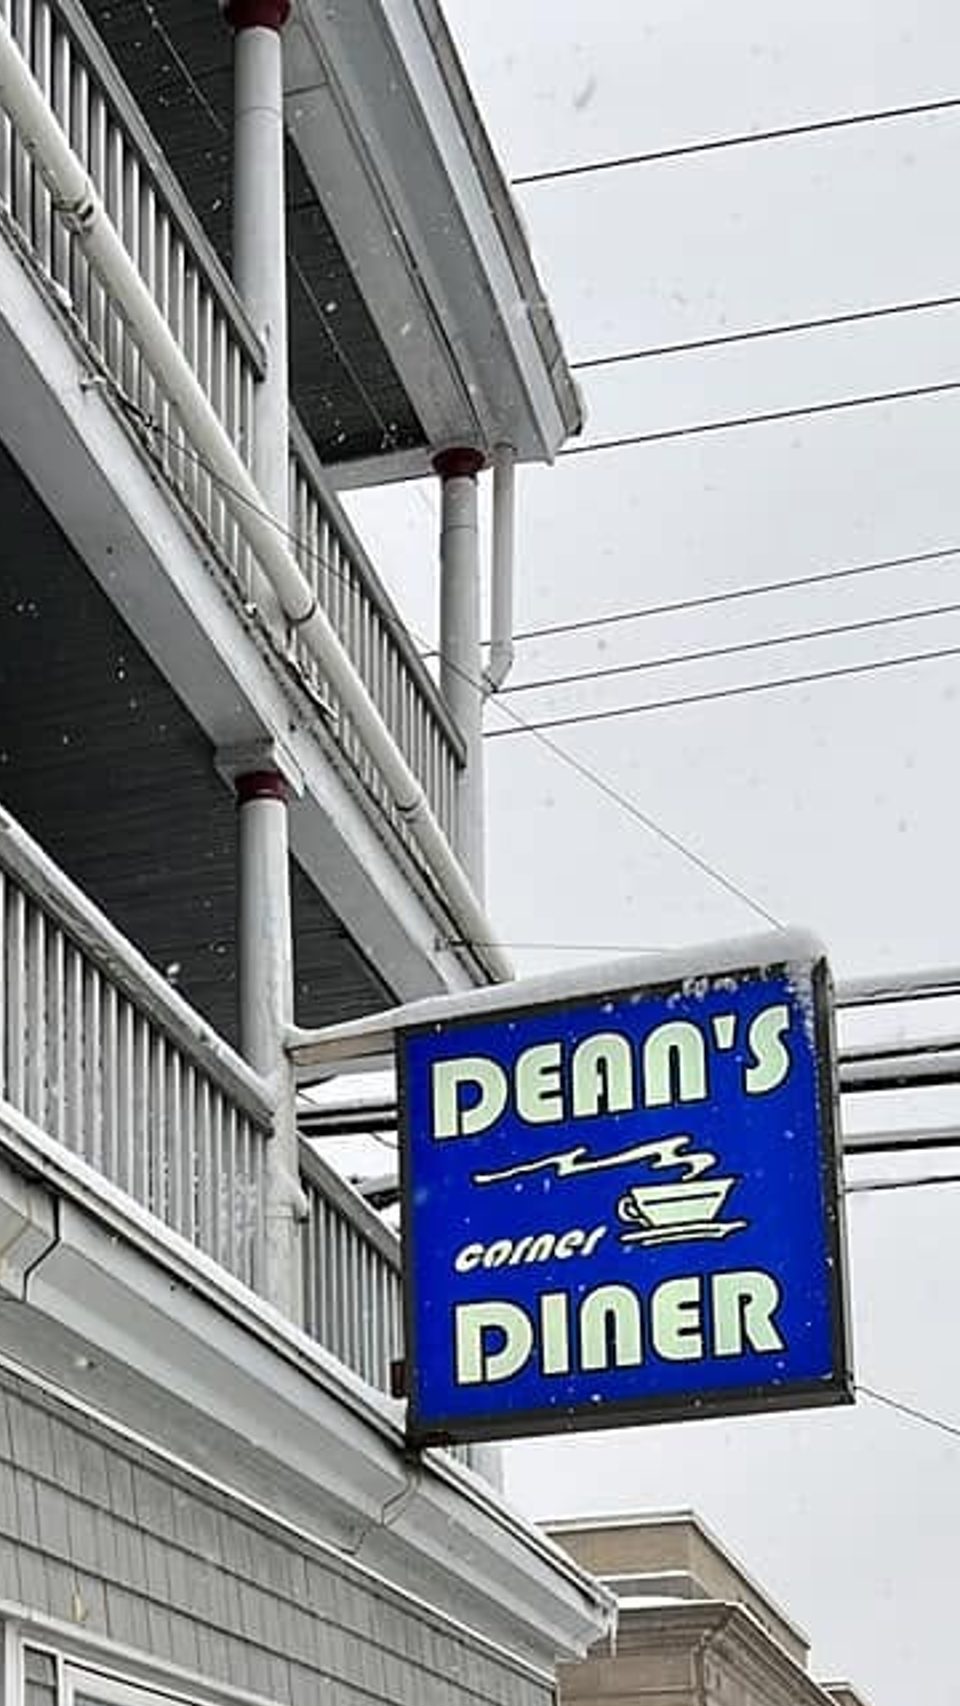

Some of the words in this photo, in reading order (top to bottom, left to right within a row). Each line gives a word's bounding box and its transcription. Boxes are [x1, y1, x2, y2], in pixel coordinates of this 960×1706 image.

[433, 1005, 790, 1139] DEAN'S
[455, 1227, 606, 1272] corner
[455, 1271, 784, 1385] DINER
